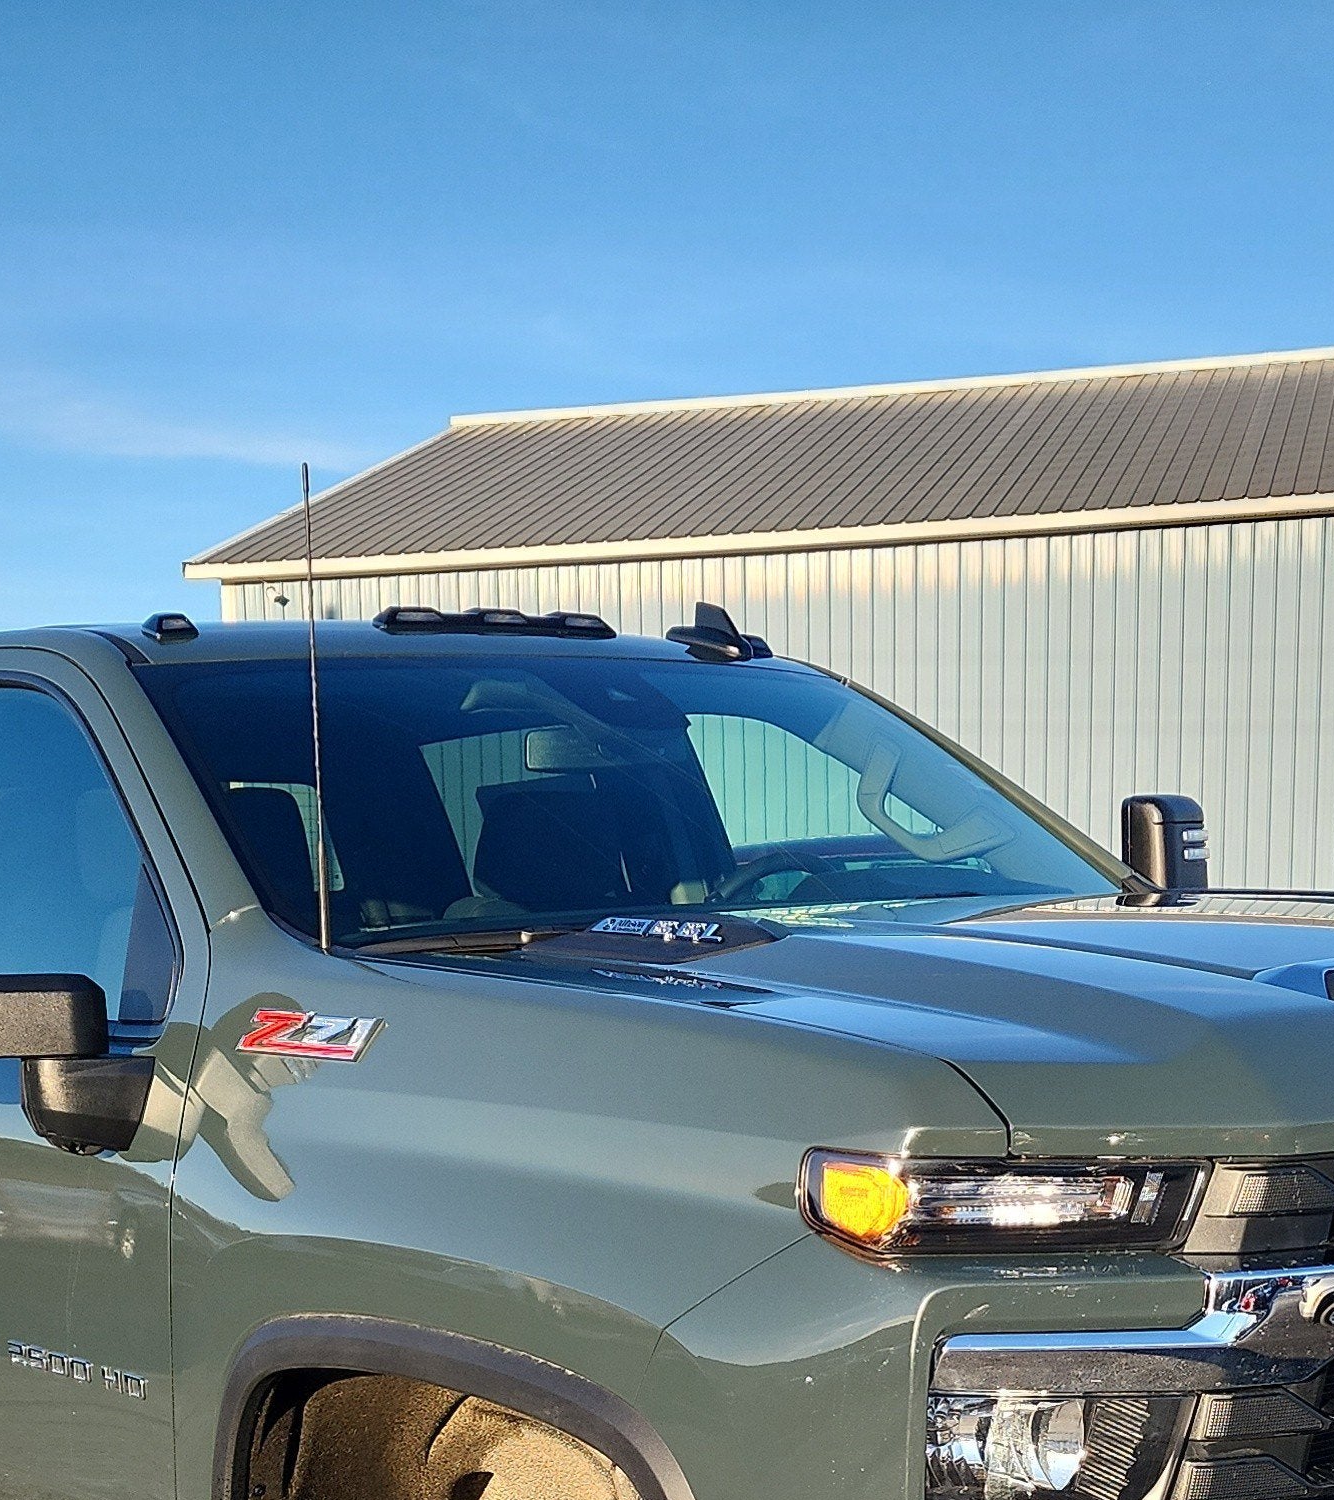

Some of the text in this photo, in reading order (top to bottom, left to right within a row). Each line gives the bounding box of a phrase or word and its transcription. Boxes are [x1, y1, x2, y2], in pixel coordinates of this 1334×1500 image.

[235, 1007, 388, 1062] Z71
[7, 1340, 149, 1400] 2500 HD
